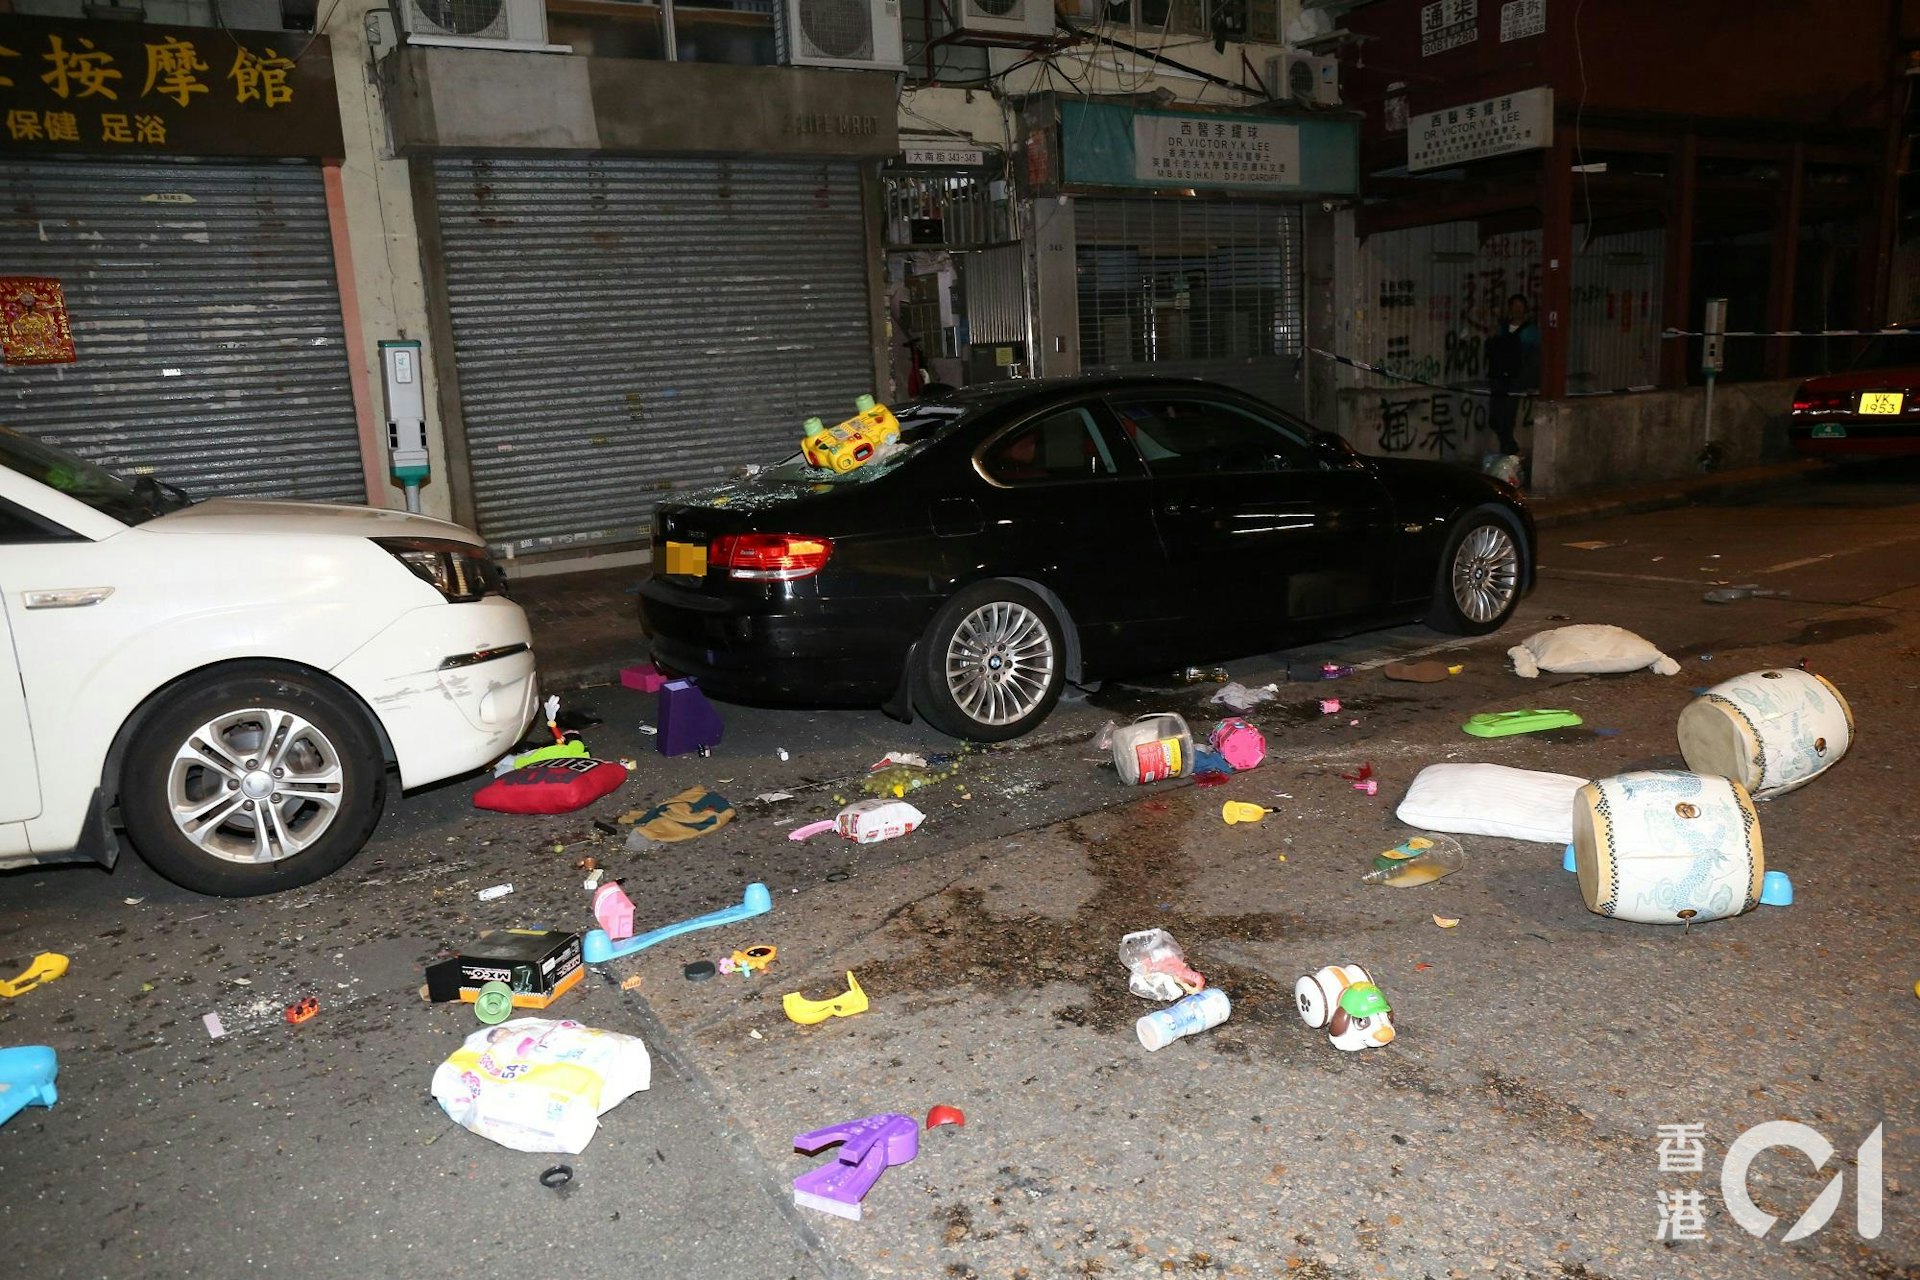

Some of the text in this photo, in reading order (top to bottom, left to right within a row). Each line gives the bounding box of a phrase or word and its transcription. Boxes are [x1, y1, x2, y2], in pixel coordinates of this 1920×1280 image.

[1423, 31, 1476, 54] 90817280
[0, 34, 296, 107] 按摩館
[6, 109, 168, 144] 保健 足浴
[1442, 121, 1477, 136] VICTOR
[1502, 110, 1520, 124] LEE
[1188, 138, 1228, 149] VICTOR
[1252, 142, 1270, 151] LEE
[913, 152, 977, 163] 大南街 343-345
[1874, 394, 1891, 404] VK
[1865, 403, 1896, 414] 1953
